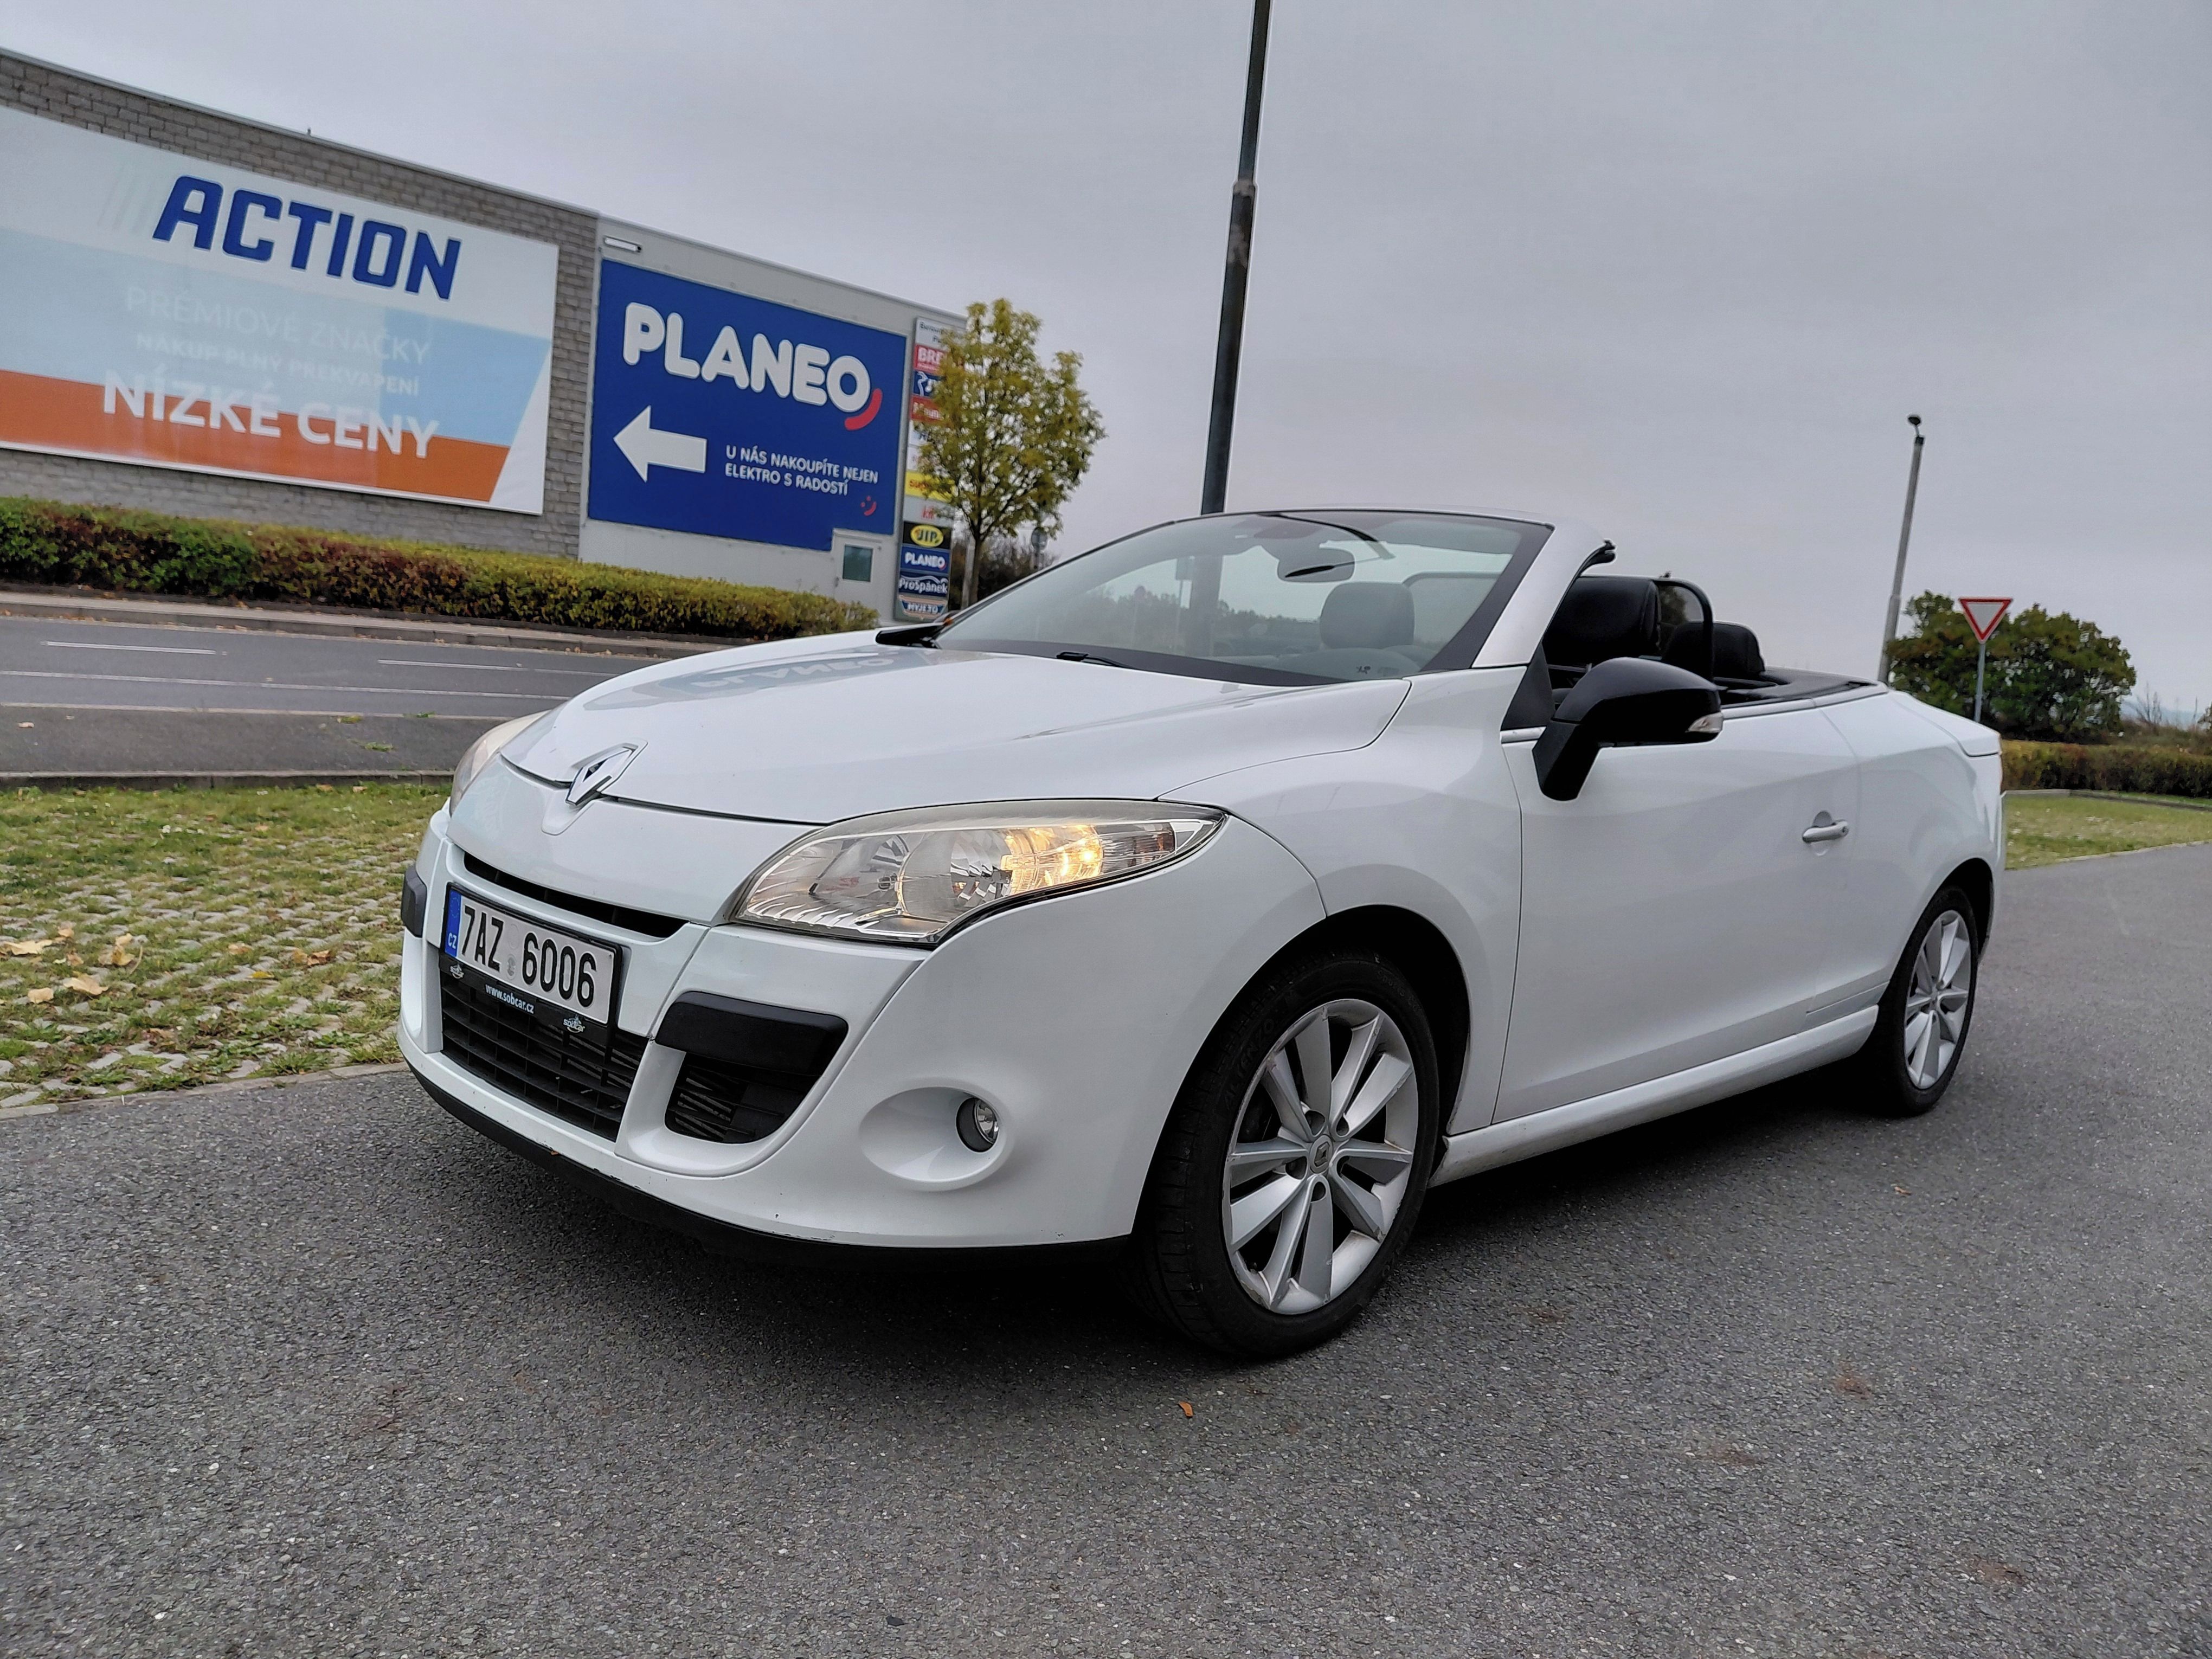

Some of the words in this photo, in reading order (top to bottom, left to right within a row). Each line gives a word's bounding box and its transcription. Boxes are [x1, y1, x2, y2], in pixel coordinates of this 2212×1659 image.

[152, 175, 461, 301] ACTION
[623, 301, 871, 413] PLANEO
[104, 363, 281, 439] NÍZKÉ
[297, 402, 440, 459] CENY
[725, 444, 737, 460] U
[740, 445, 767, 465] NÁS
[770, 452, 840, 478] NAKOUPÍTE
[843, 465, 878, 484] NEJEN
[725, 462, 781, 485] ELEKTRO
[783, 472, 793, 487] S
[795, 474, 848, 496] RADOSTÍ
[905, 552, 946, 569] PLANEO
[448, 932, 457, 949] CZ
[462, 905, 504, 973] 7AZ
[522, 932, 597, 1008] 6006
[485, 984, 534, 1014] www.sobcar.cz
